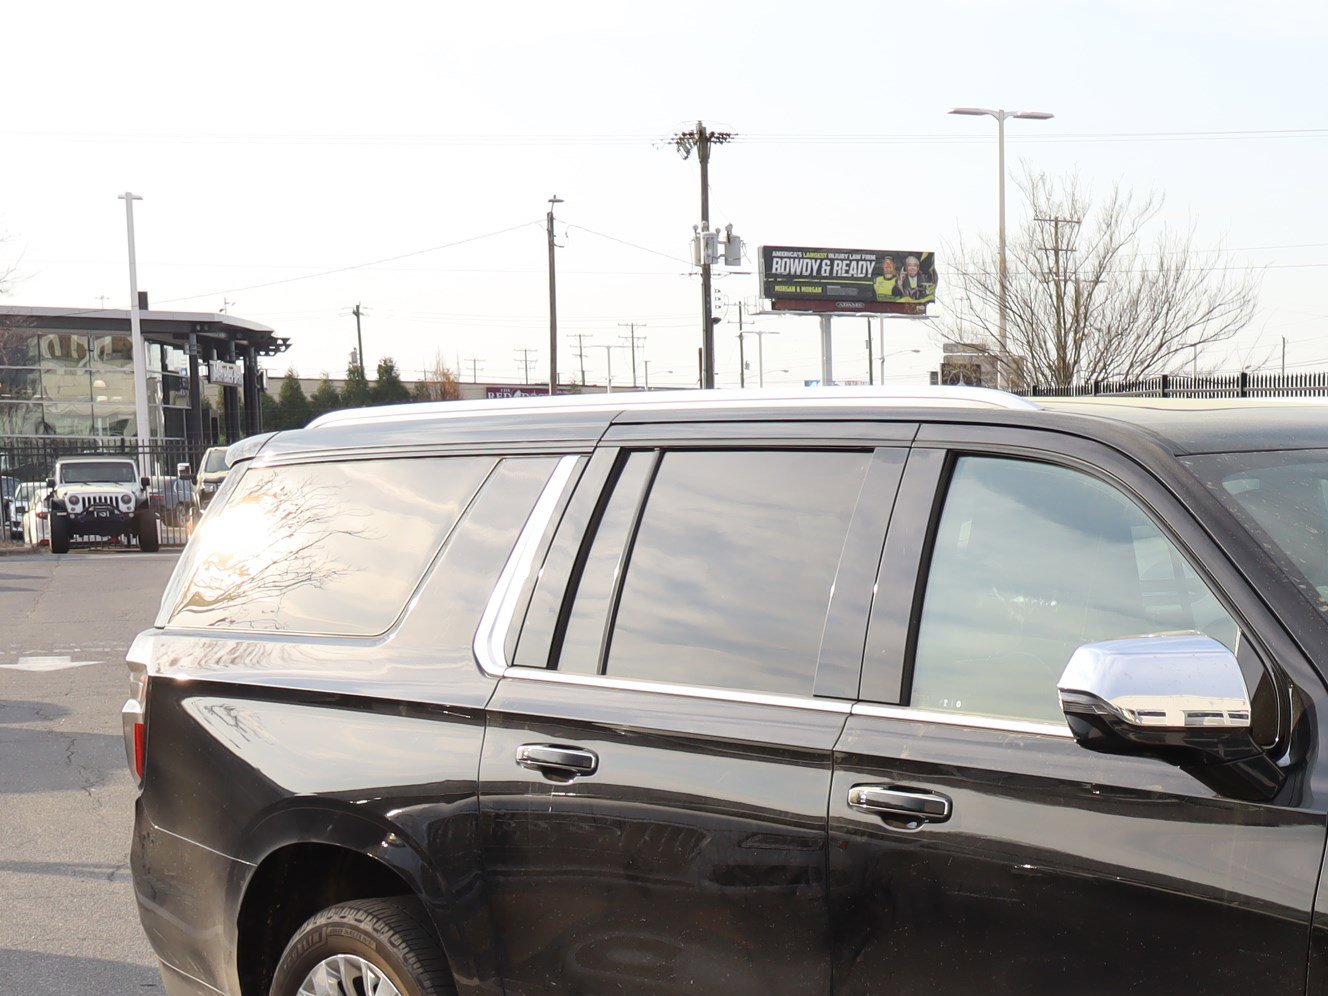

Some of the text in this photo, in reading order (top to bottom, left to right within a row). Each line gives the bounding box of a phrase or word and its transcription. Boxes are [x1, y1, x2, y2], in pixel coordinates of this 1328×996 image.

[772, 257, 876, 278] ROWDY & READY
